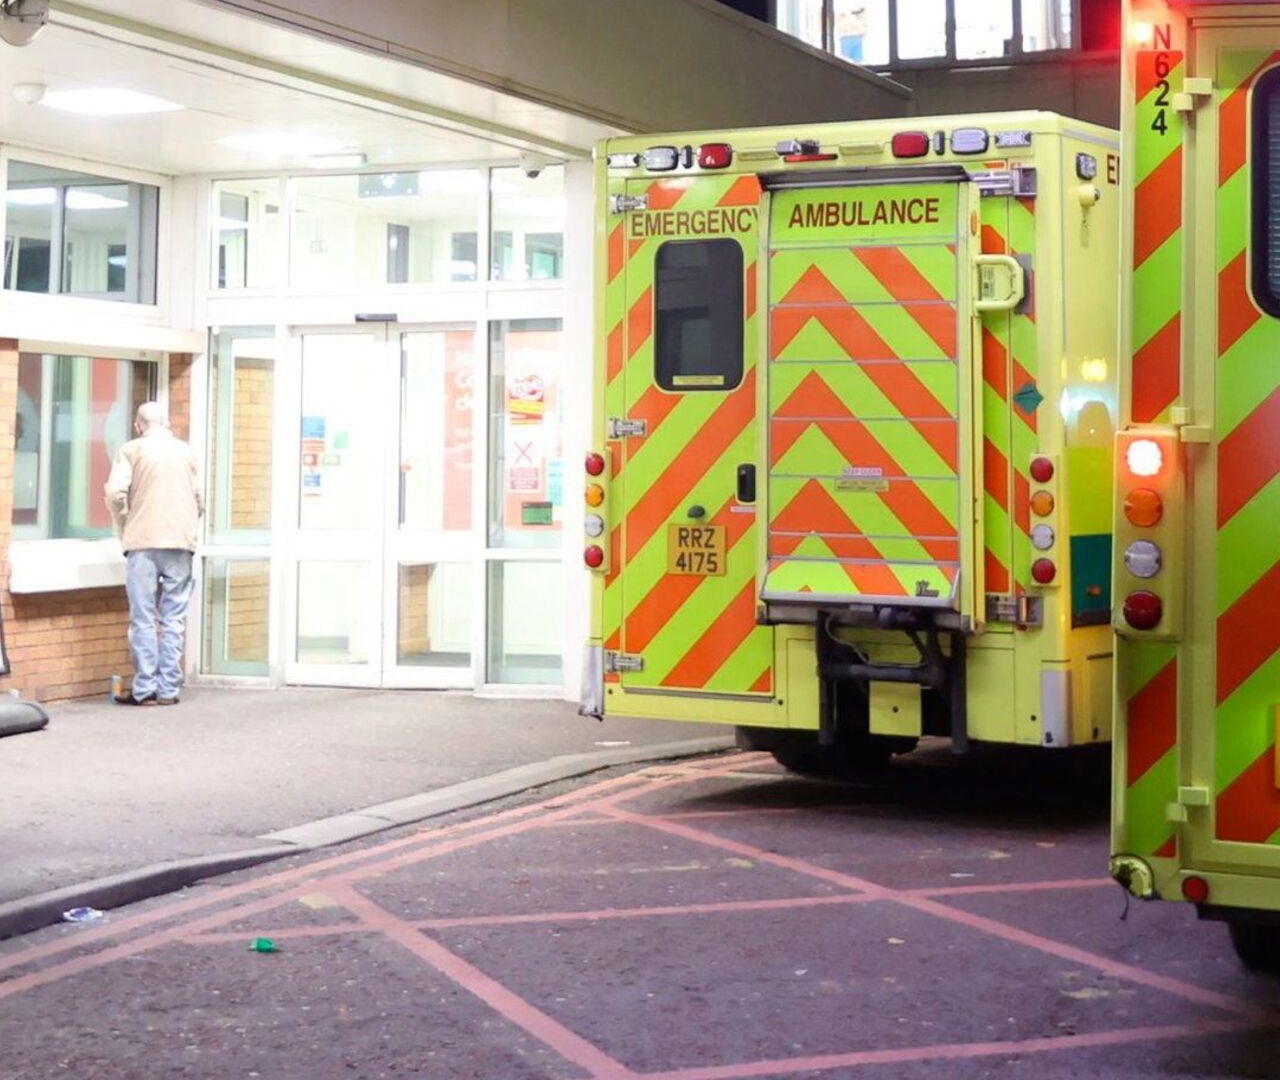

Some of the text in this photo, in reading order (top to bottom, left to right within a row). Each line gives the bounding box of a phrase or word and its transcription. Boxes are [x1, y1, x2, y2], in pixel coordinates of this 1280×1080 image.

[788, 198, 939, 228] AMBULANCE
[678, 527, 715, 548] RRZ
[675, 552, 717, 573] 4175
